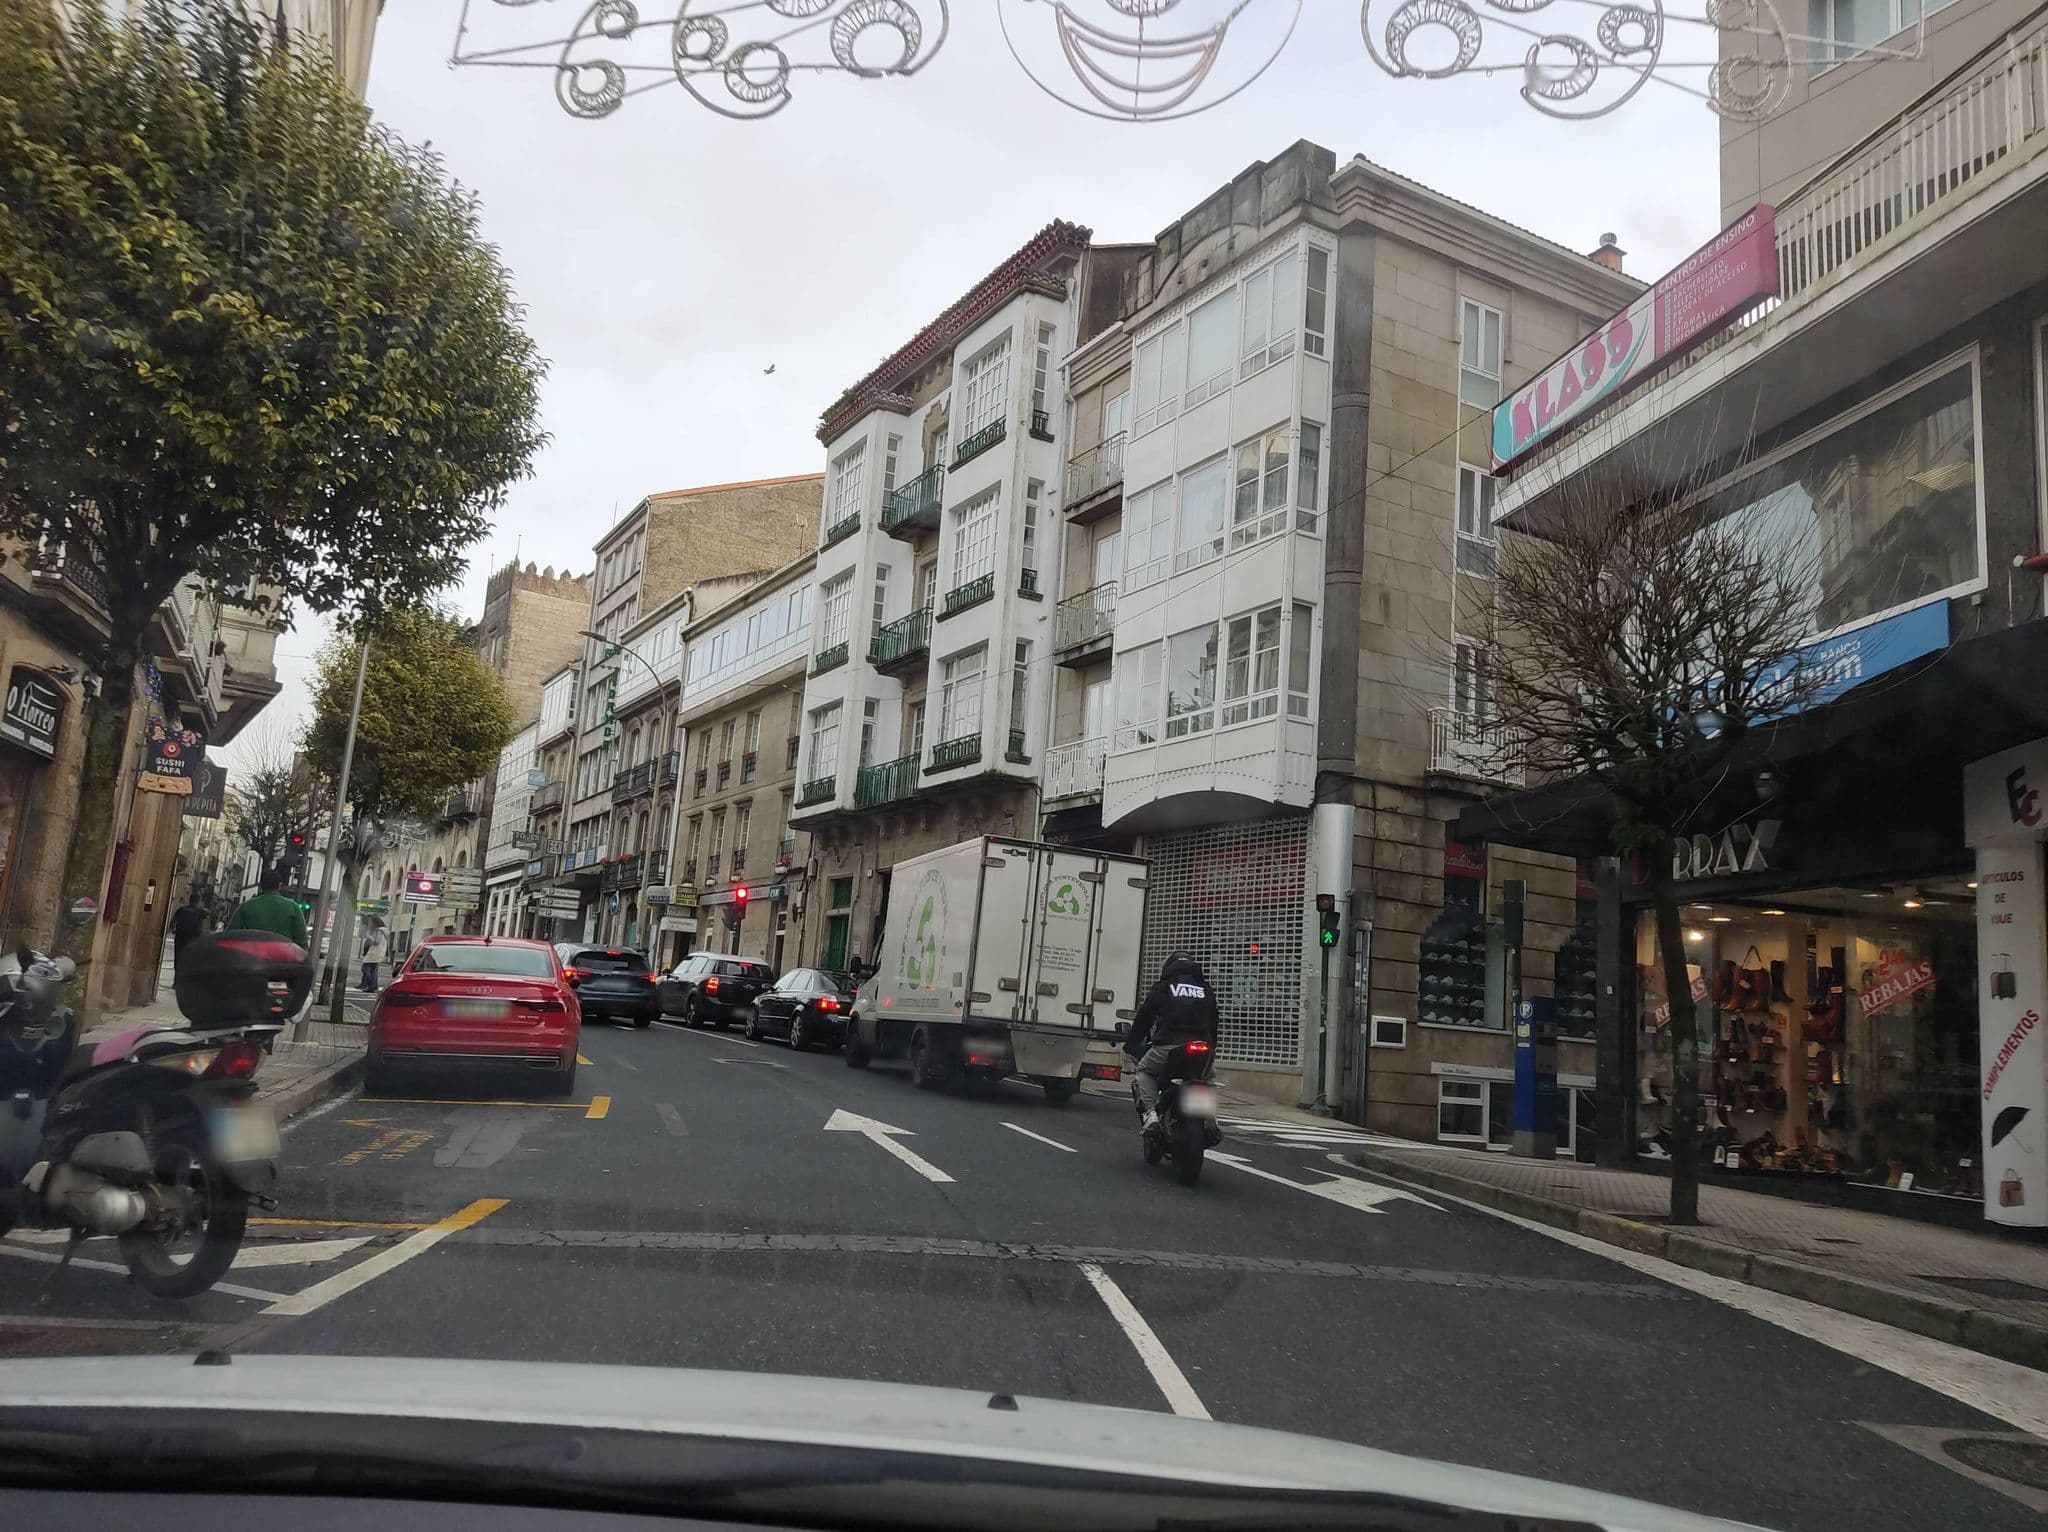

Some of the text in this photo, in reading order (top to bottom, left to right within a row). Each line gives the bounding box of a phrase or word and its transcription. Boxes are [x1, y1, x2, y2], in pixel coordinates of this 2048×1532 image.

[1659, 214, 1755, 293] CENTRO DE ENSINO
[1820, 639, 1861, 662] BANCO
[155, 757, 185, 768] SUSHI
[157, 765, 181, 776] FAFA
[1995, 892, 2006, 904] DE
[1170, 983, 1205, 999] VANS
[1859, 961, 1932, 1012] REBAJAS
